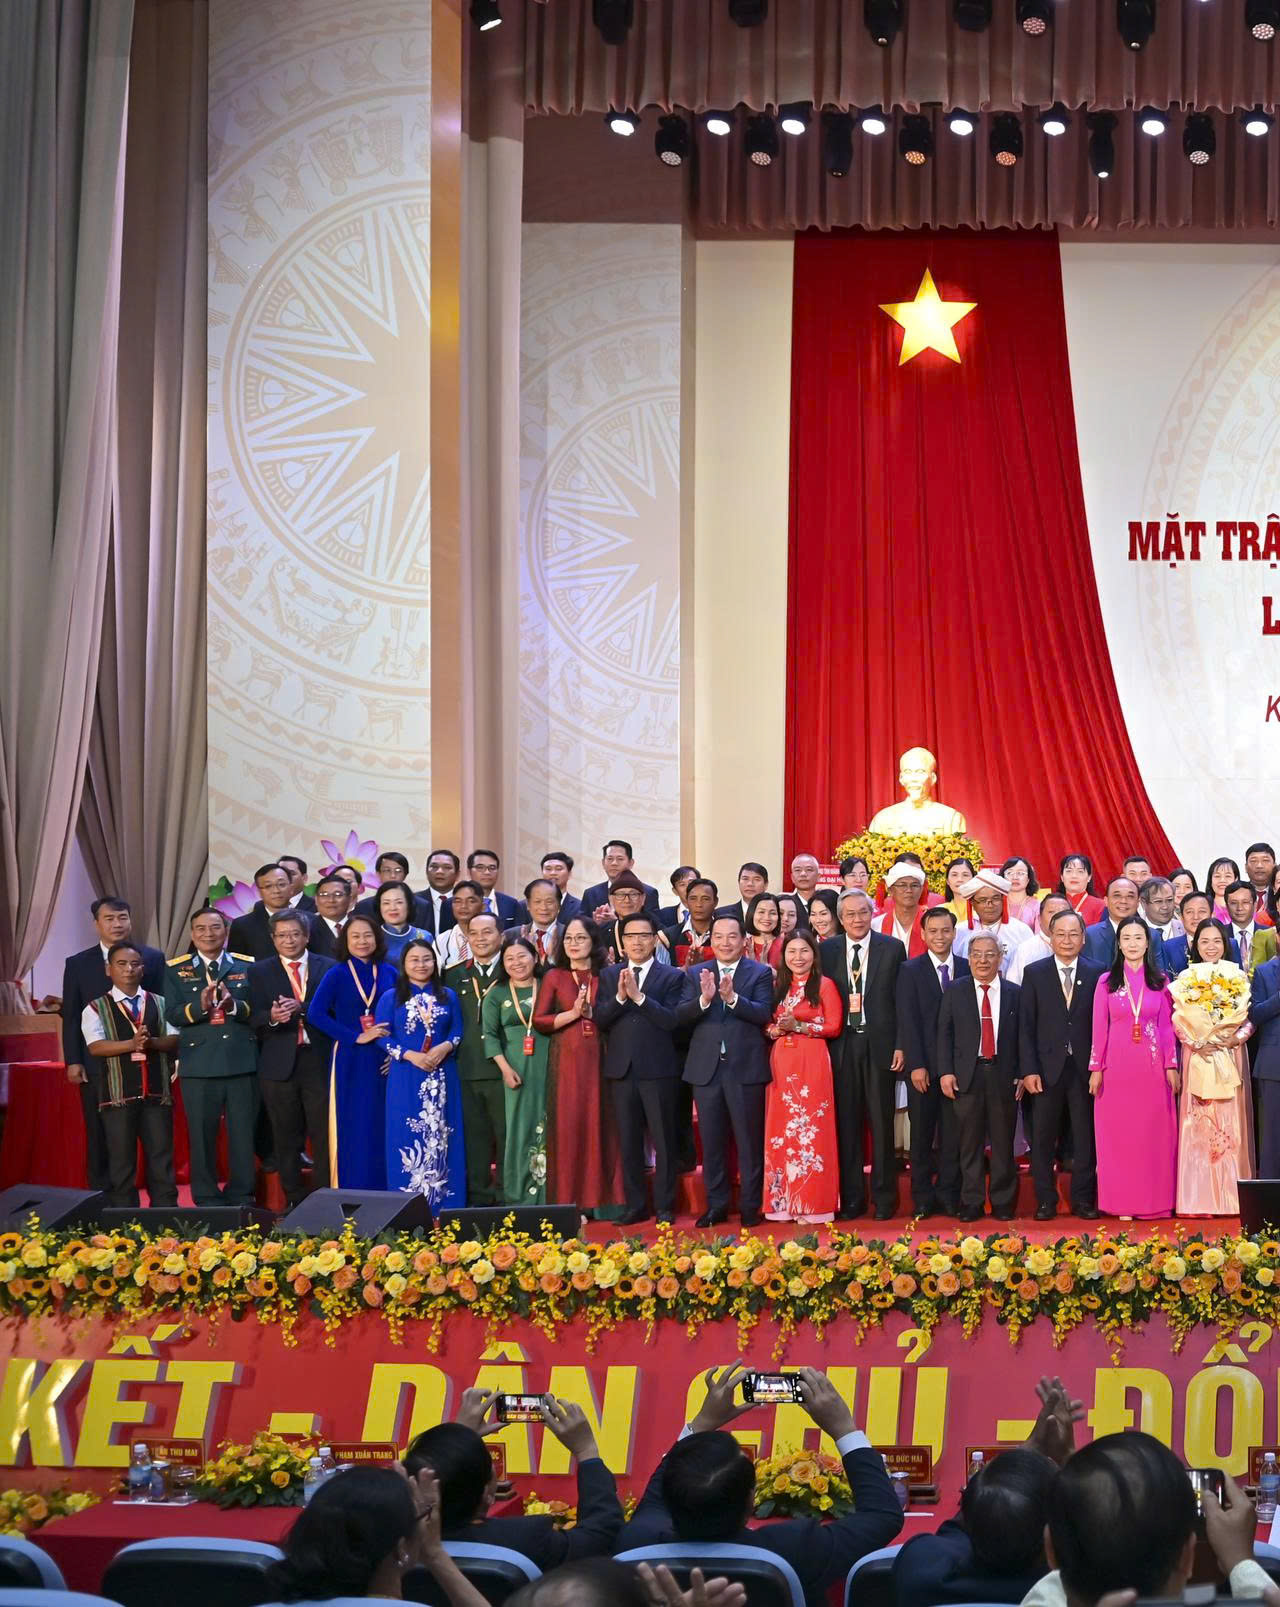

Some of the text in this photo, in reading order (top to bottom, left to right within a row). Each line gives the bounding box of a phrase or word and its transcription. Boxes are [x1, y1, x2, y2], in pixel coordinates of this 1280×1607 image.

[1127, 513, 1207, 569] MẶT
[0, 1323, 236, 1468] KẾT
[360, 1341, 639, 1474] DÂN
